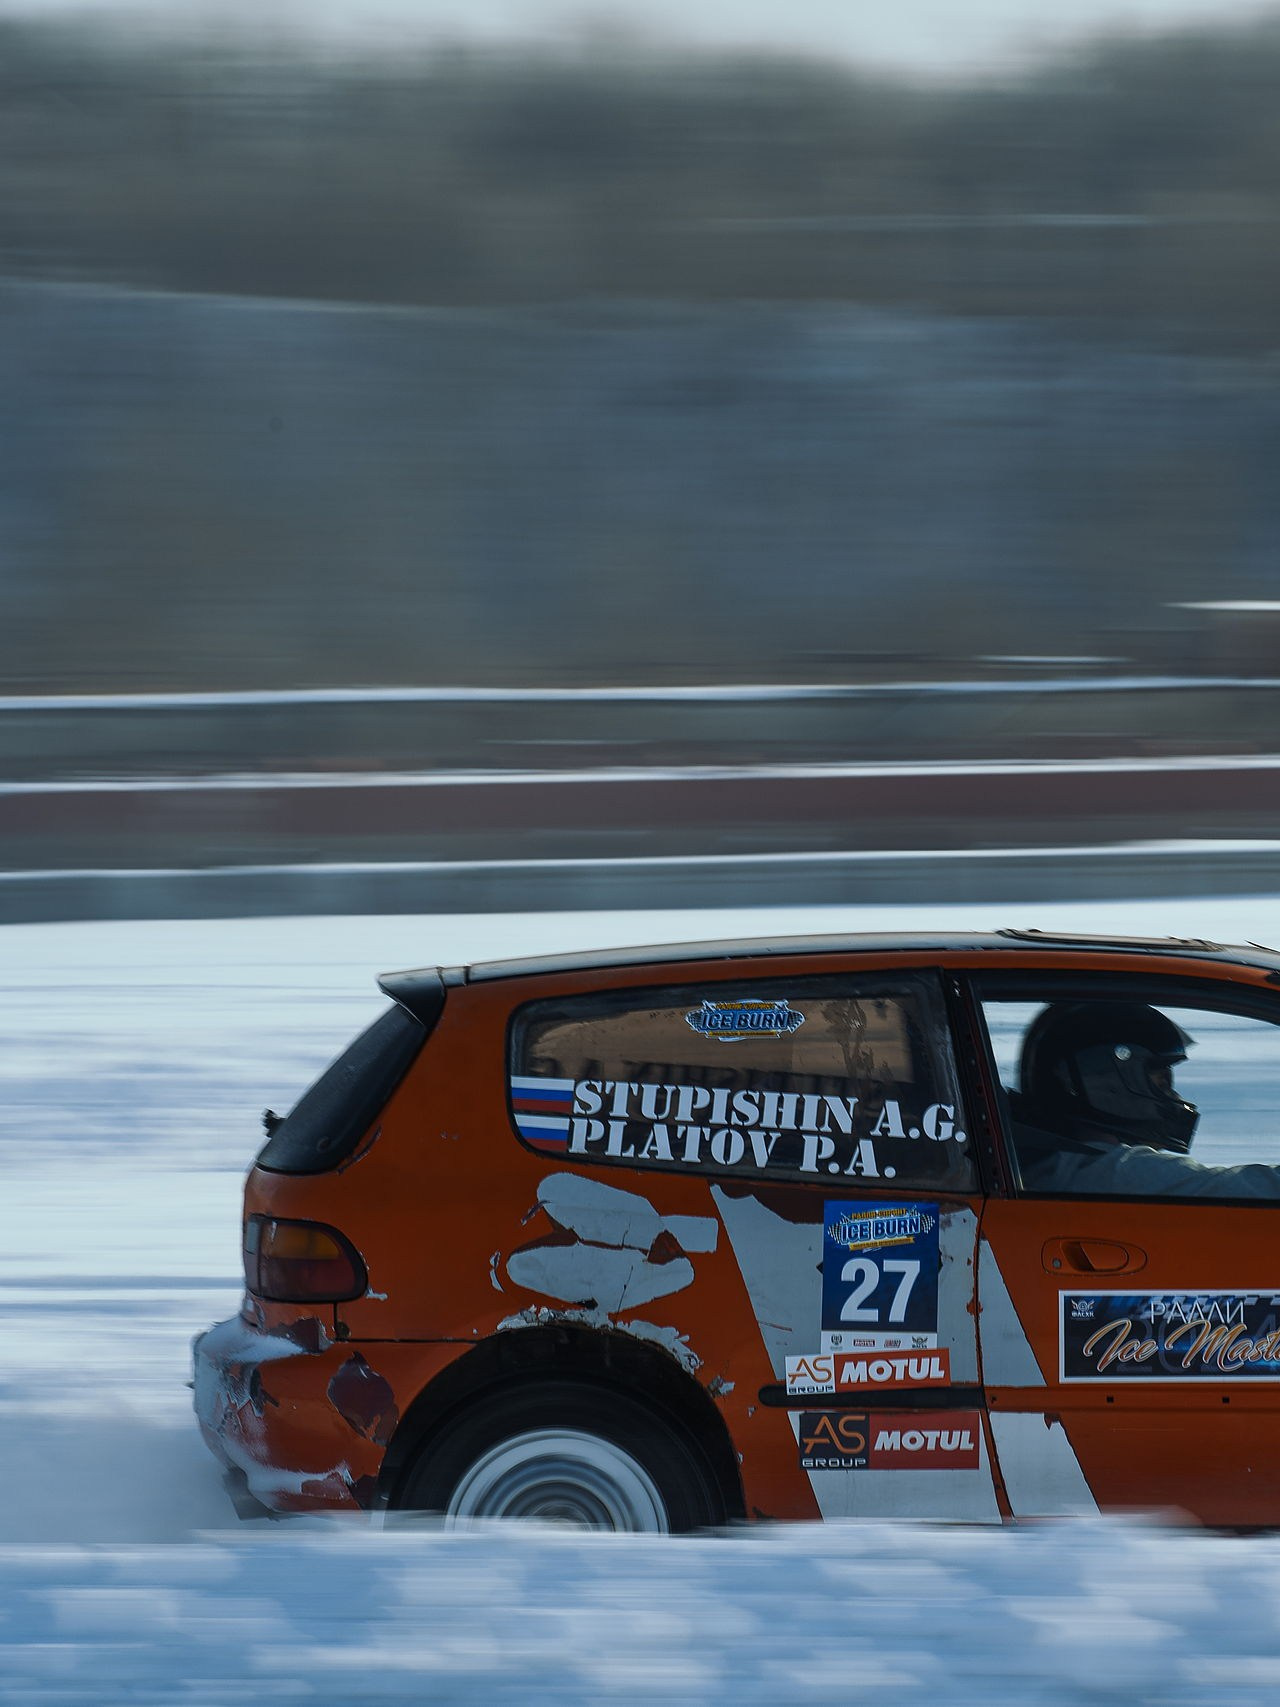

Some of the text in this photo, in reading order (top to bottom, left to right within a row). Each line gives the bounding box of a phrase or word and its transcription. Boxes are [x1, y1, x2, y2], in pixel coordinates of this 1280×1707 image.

[702, 1012, 788, 1030] ICE BURN
[572, 1079, 967, 1143] STUPISHIN A.G.
[567, 1116, 897, 1179] PLATOV P.A.
[841, 1216, 920, 1243] ICE BURN
[839, 1258, 921, 1323] 27
[1150, 1300, 1244, 1325] РАЛЛИ
[1083, 1318, 1159, 1372] Ice
[787, 1356, 945, 1384] AS MOTUL
[787, 1385, 834, 1394] GROUP
[802, 1415, 974, 1454] AS MOTUL
[801, 1458, 867, 1468] GROUP
